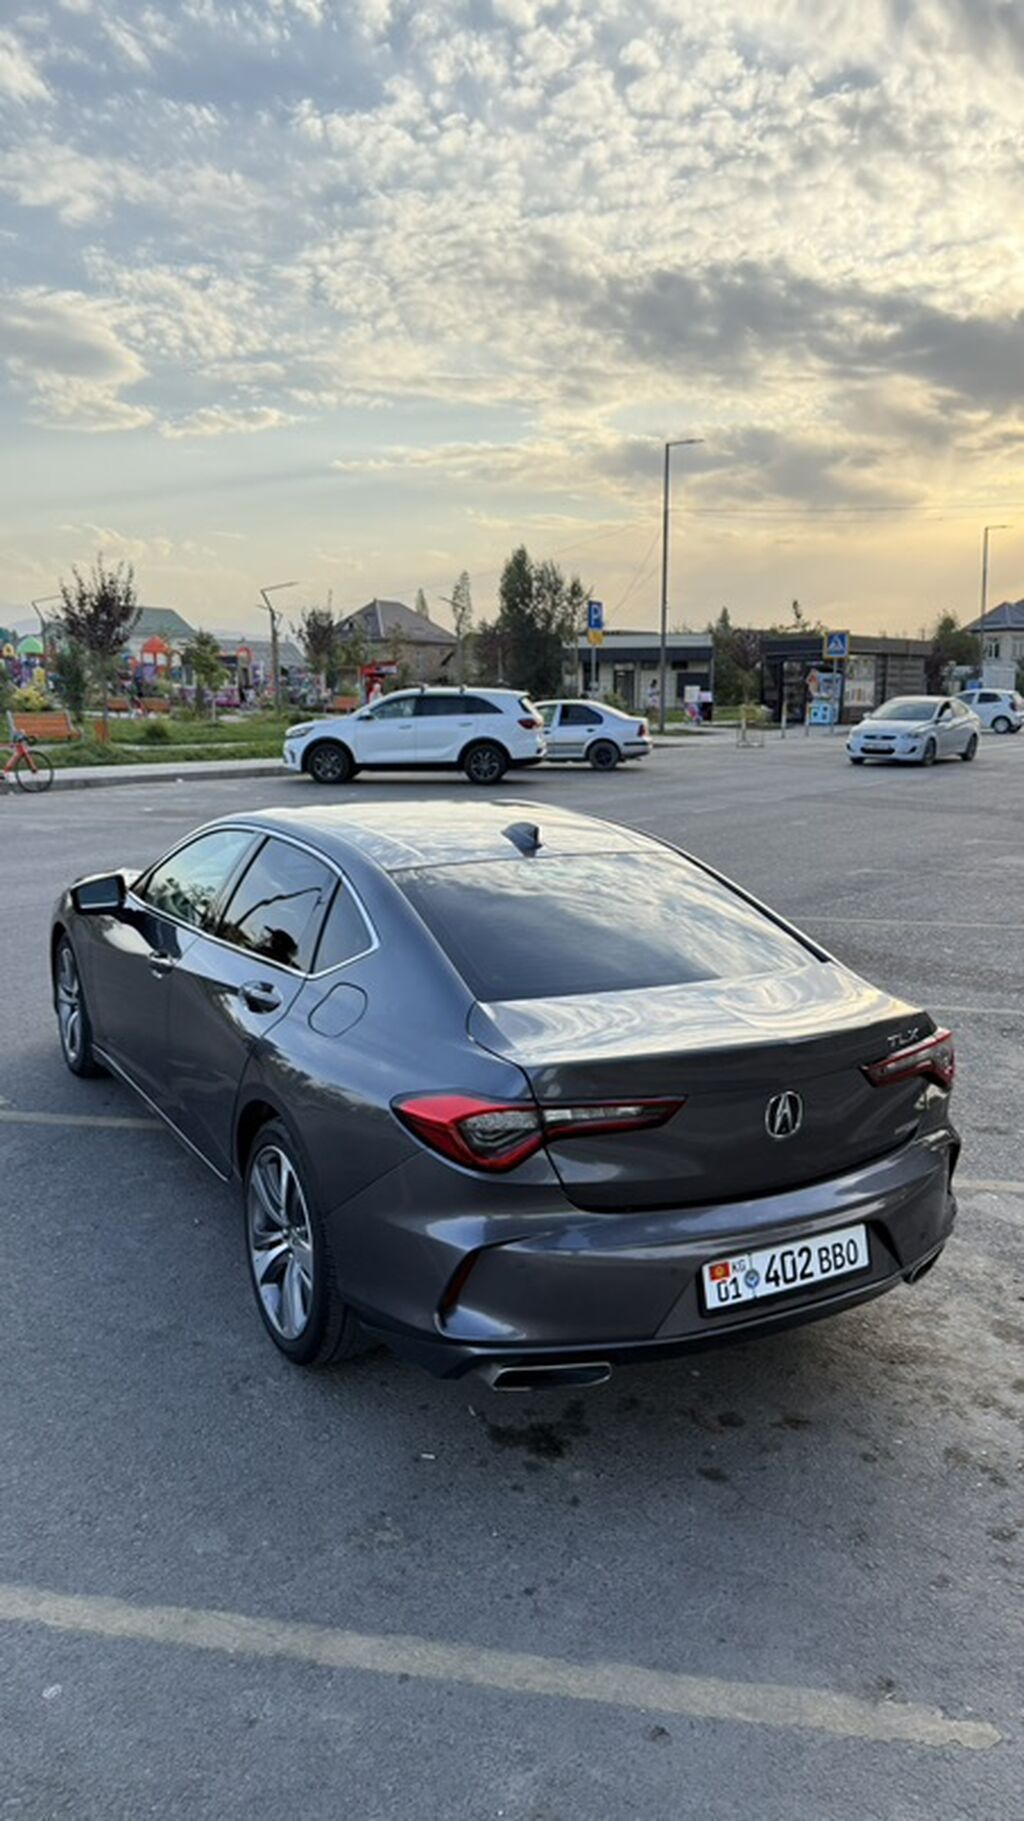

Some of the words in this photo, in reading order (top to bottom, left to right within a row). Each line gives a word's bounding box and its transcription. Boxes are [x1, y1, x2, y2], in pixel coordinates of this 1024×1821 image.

[591, 604, 602, 626] P
[888, 1028, 919, 1047] TLX
[717, 1278, 742, 1302] 01
[765, 1247, 814, 1287] 402
[732, 1260, 747, 1273] KG
